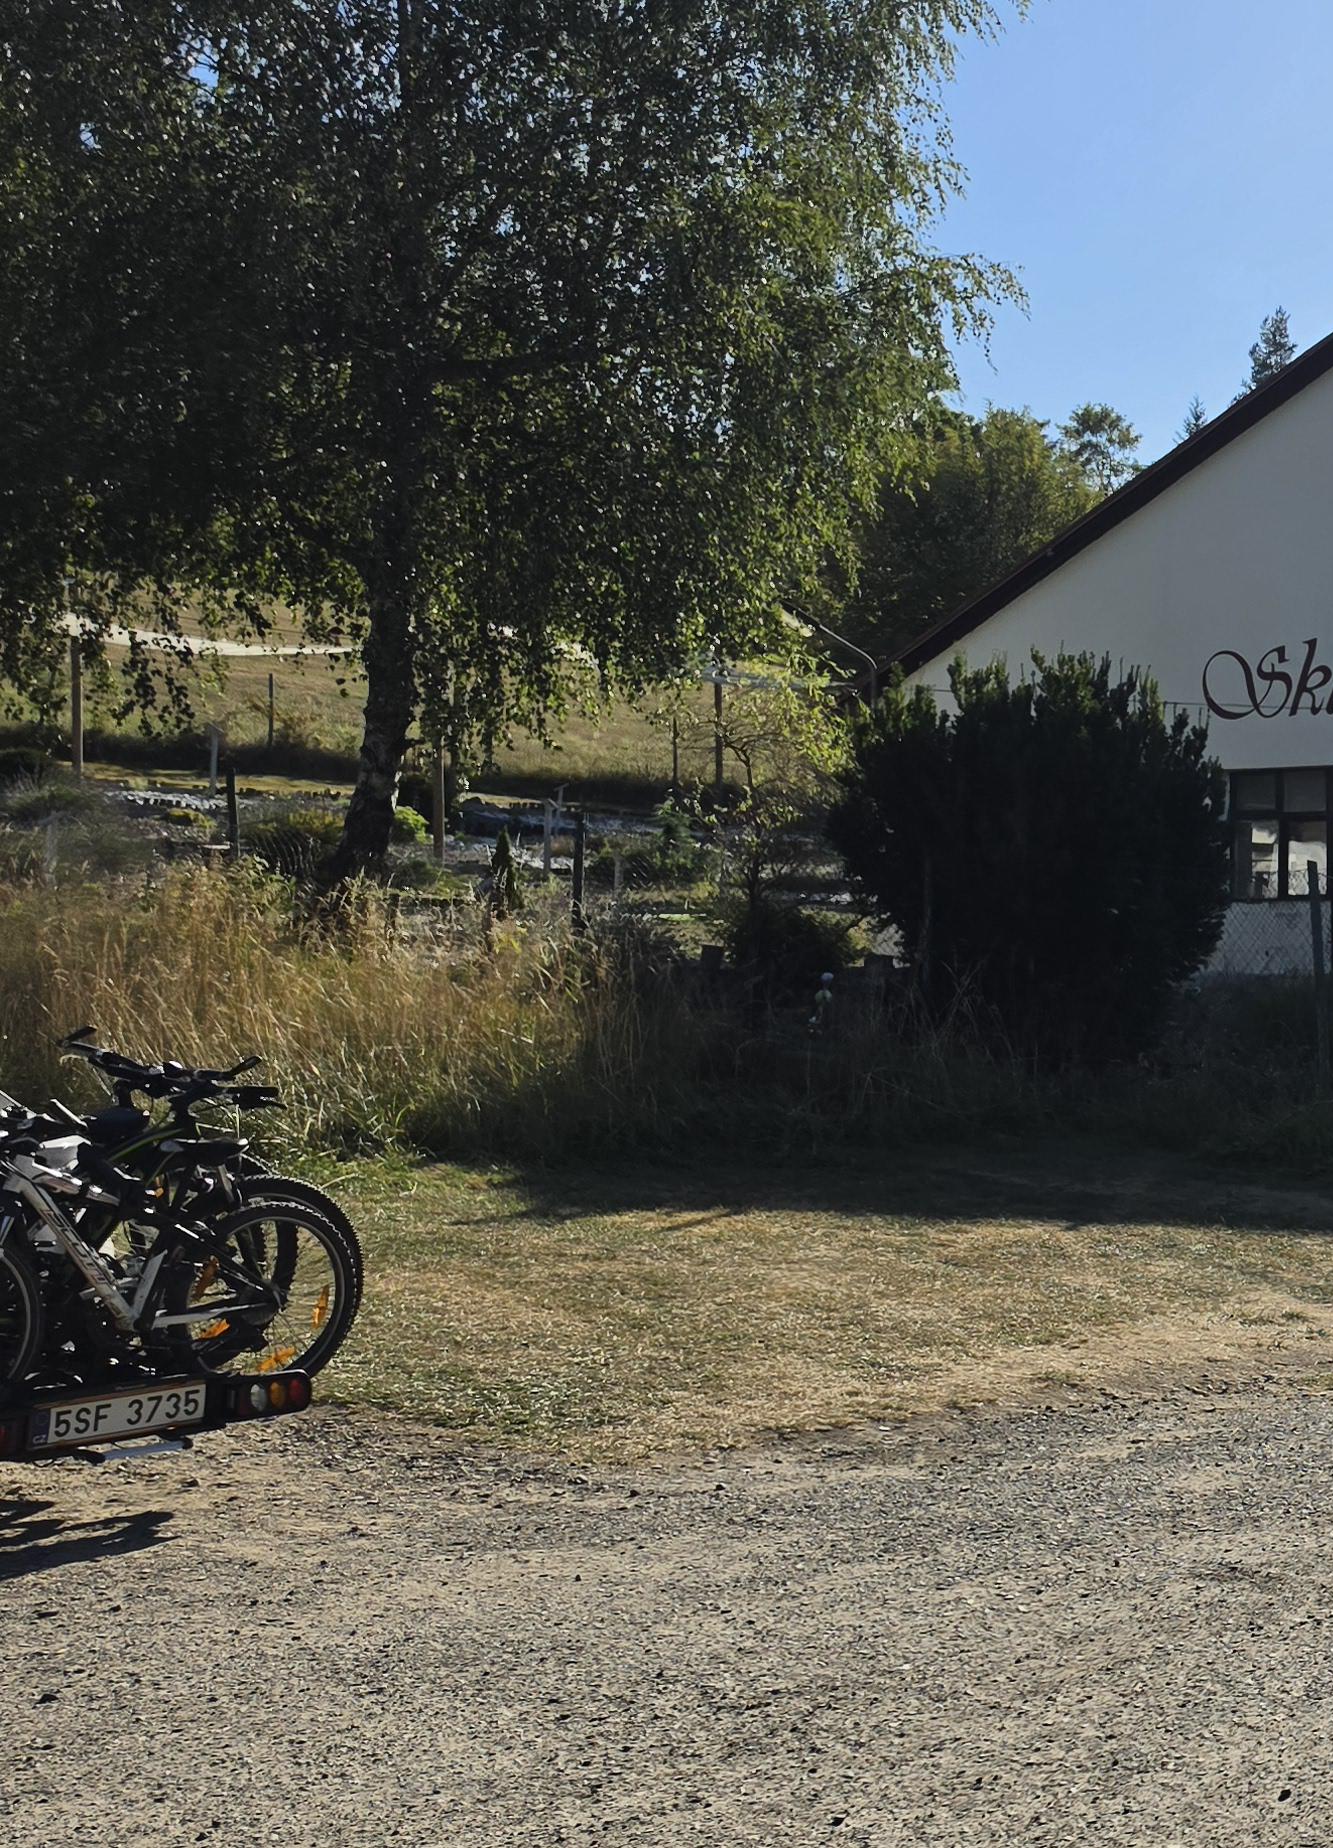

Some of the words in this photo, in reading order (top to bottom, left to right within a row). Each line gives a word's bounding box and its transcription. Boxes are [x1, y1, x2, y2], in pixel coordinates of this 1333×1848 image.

[33, 1434, 47, 1444] CZ
[54, 1403, 112, 1438] 5SF
[126, 1389, 200, 1426] 3735
